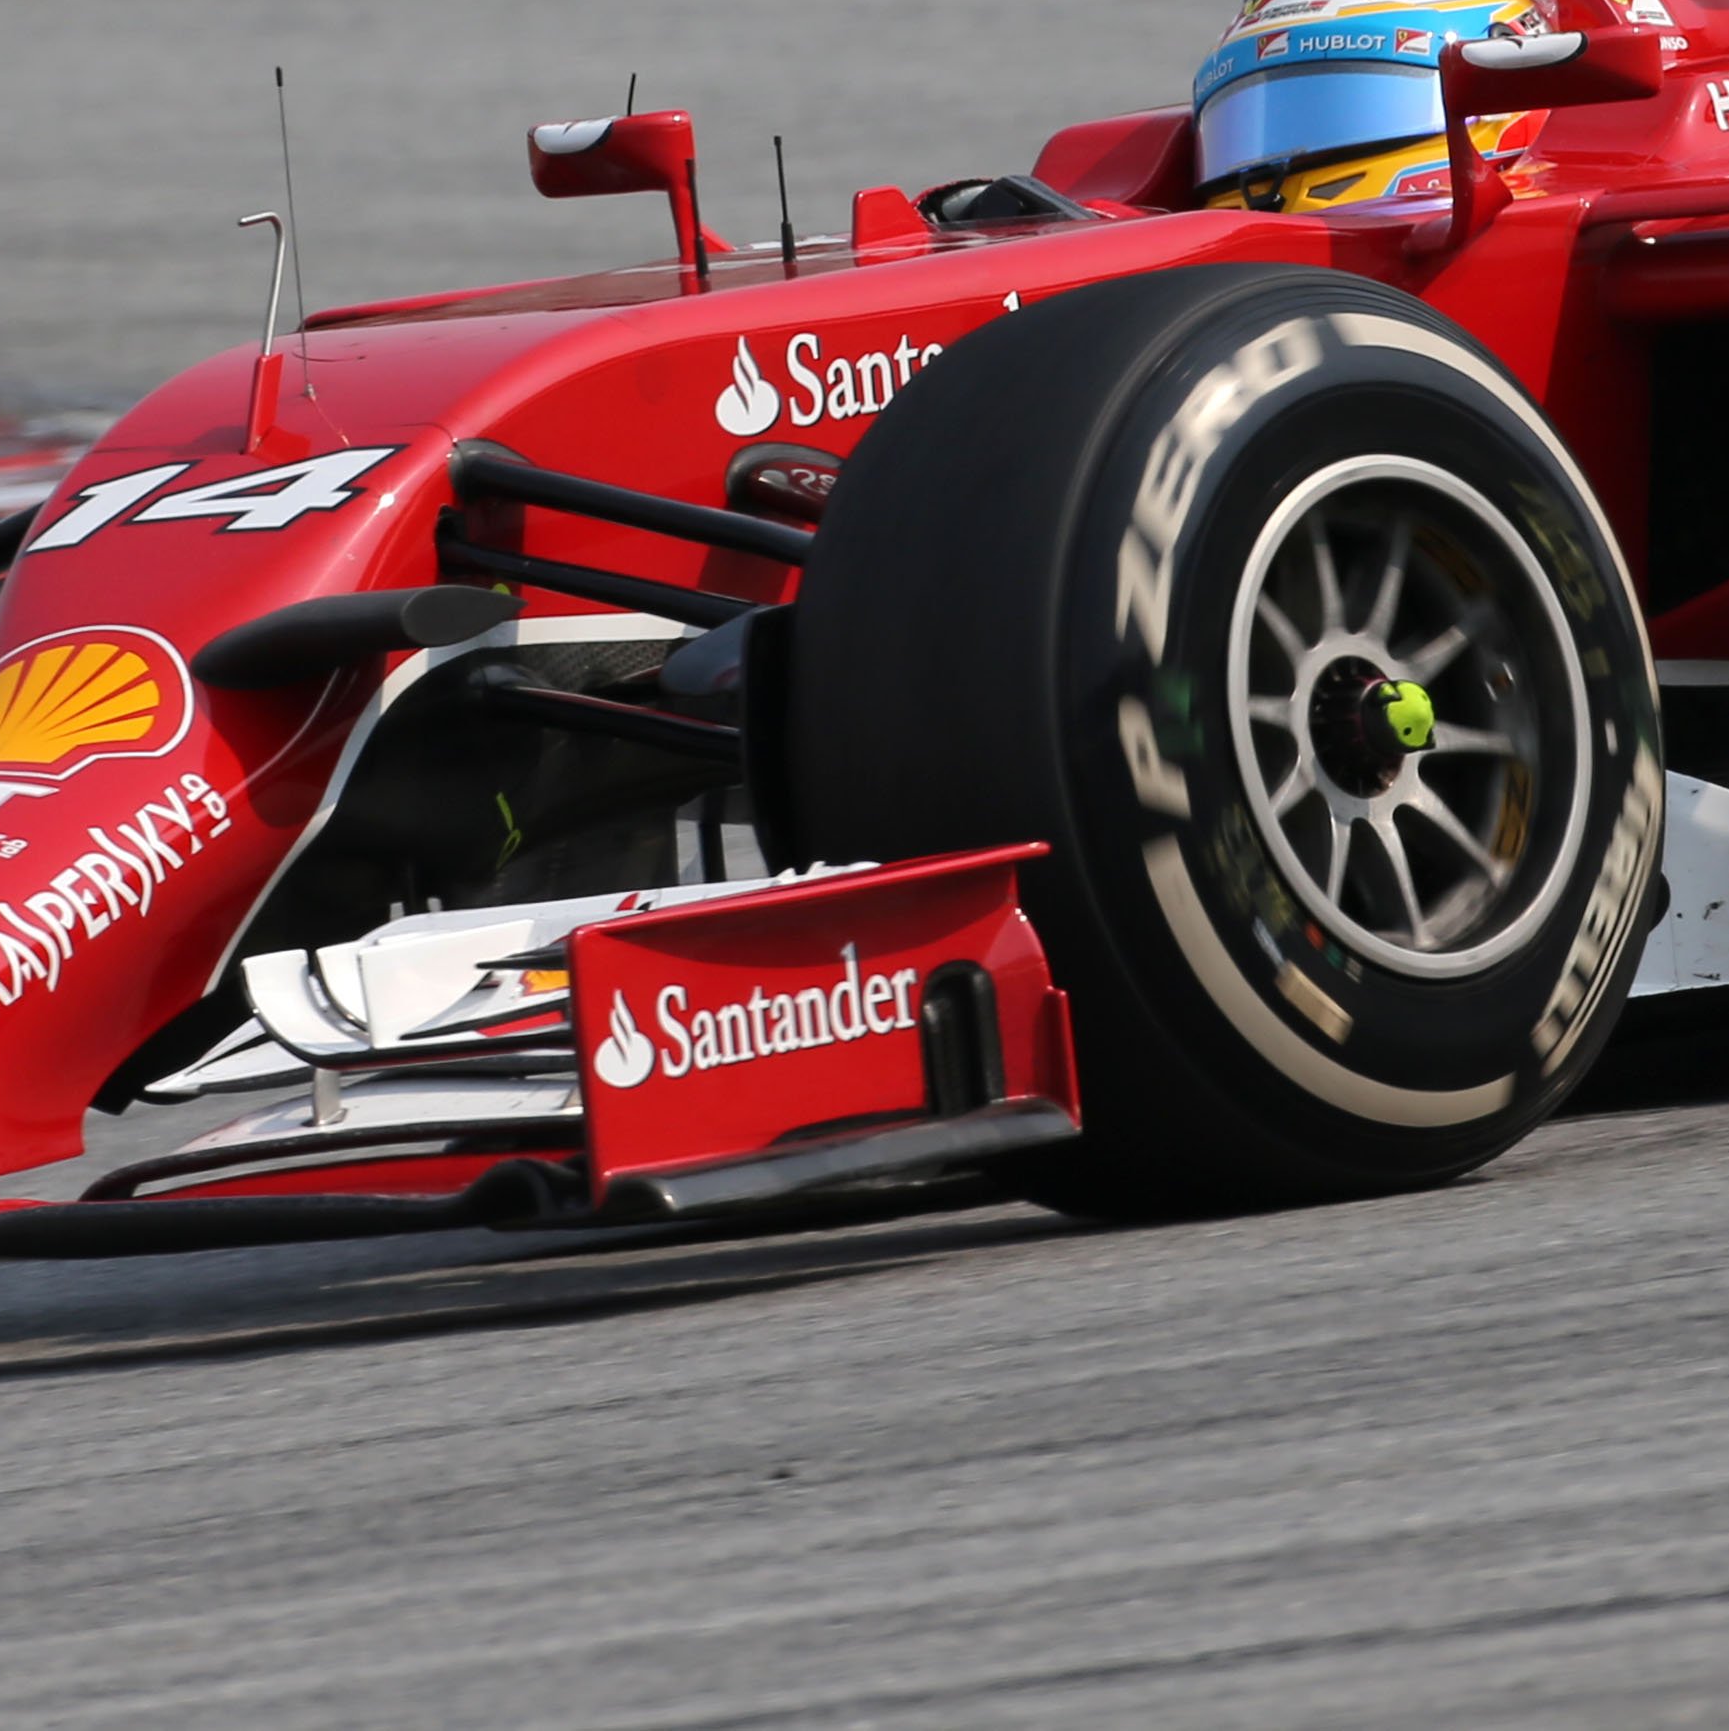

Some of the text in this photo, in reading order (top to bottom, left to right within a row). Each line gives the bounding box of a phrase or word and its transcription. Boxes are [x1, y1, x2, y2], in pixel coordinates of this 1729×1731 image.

[1299, 35, 1386, 53] HUBLOT
[22, 444, 412, 556] 14
[1114, 314, 1325, 668] ZERO
[179, 773, 232, 839] lab
[656, 941, 917, 1078] Santander
